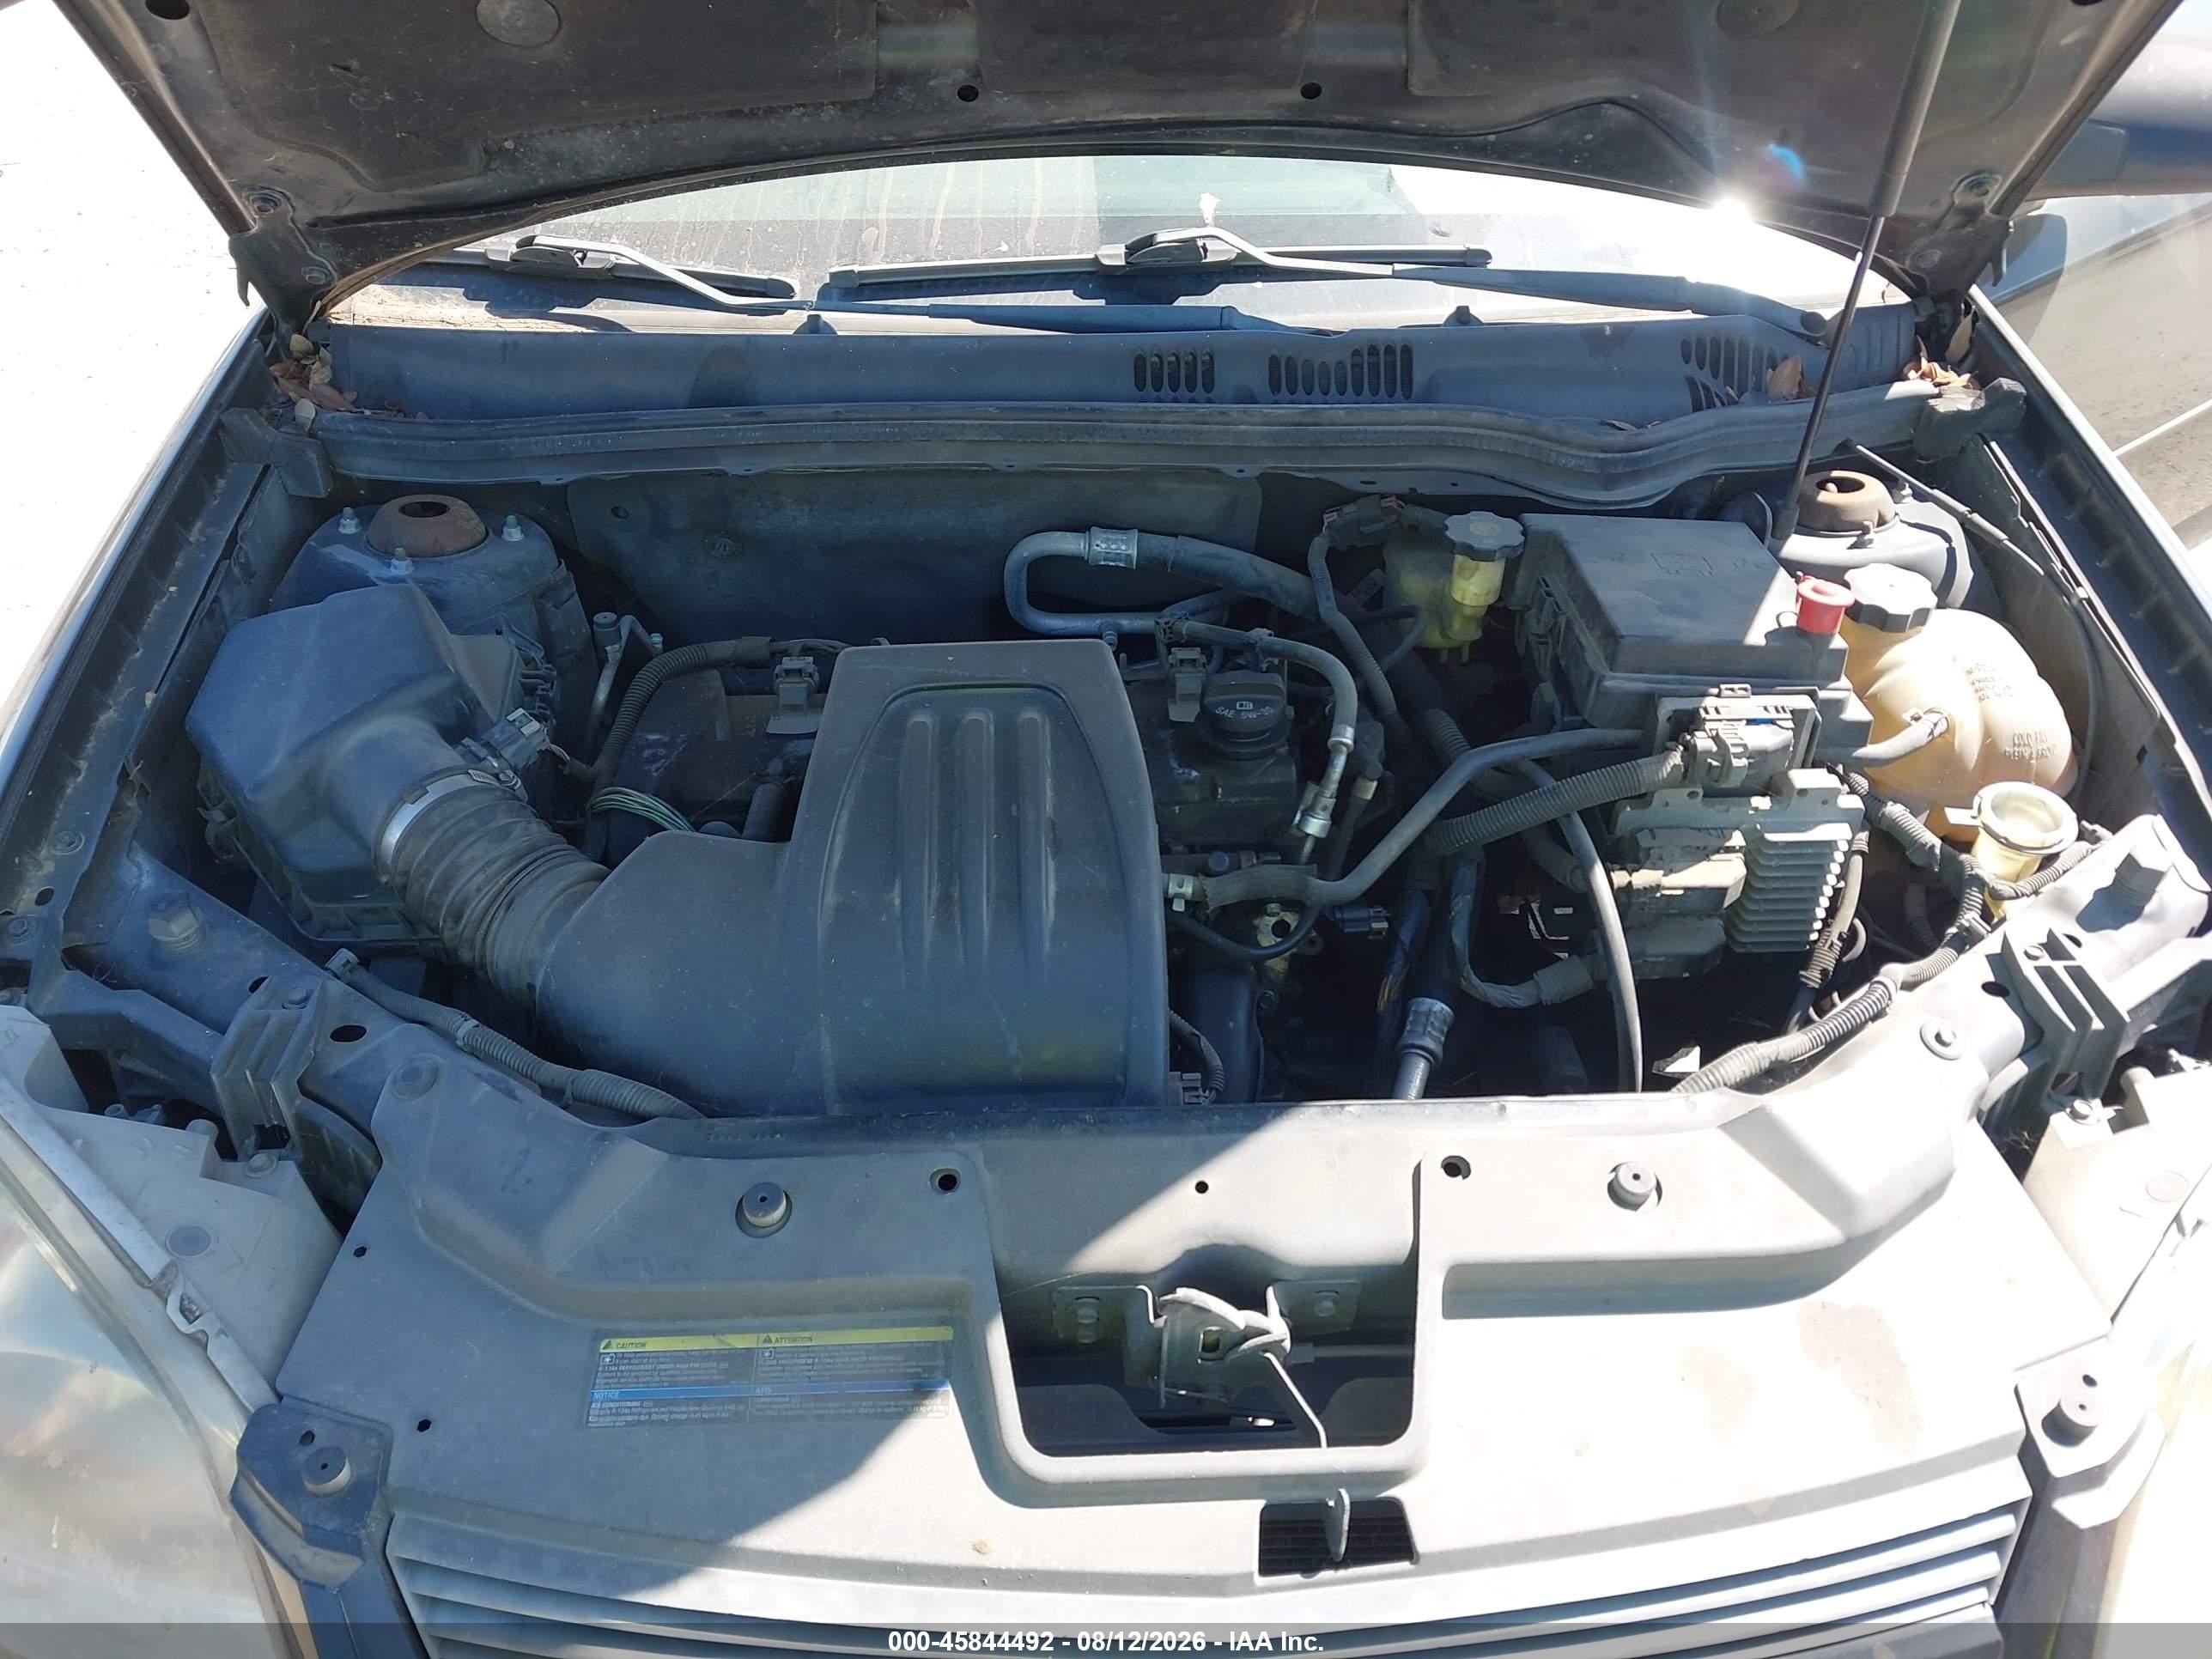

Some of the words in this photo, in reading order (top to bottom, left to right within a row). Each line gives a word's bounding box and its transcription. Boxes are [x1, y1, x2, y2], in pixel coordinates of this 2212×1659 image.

[1215, 706, 1236, 719] SAE
[774, 1335, 813, 1344] ATTENTION
[592, 1391, 620, 1400] NOTICE
